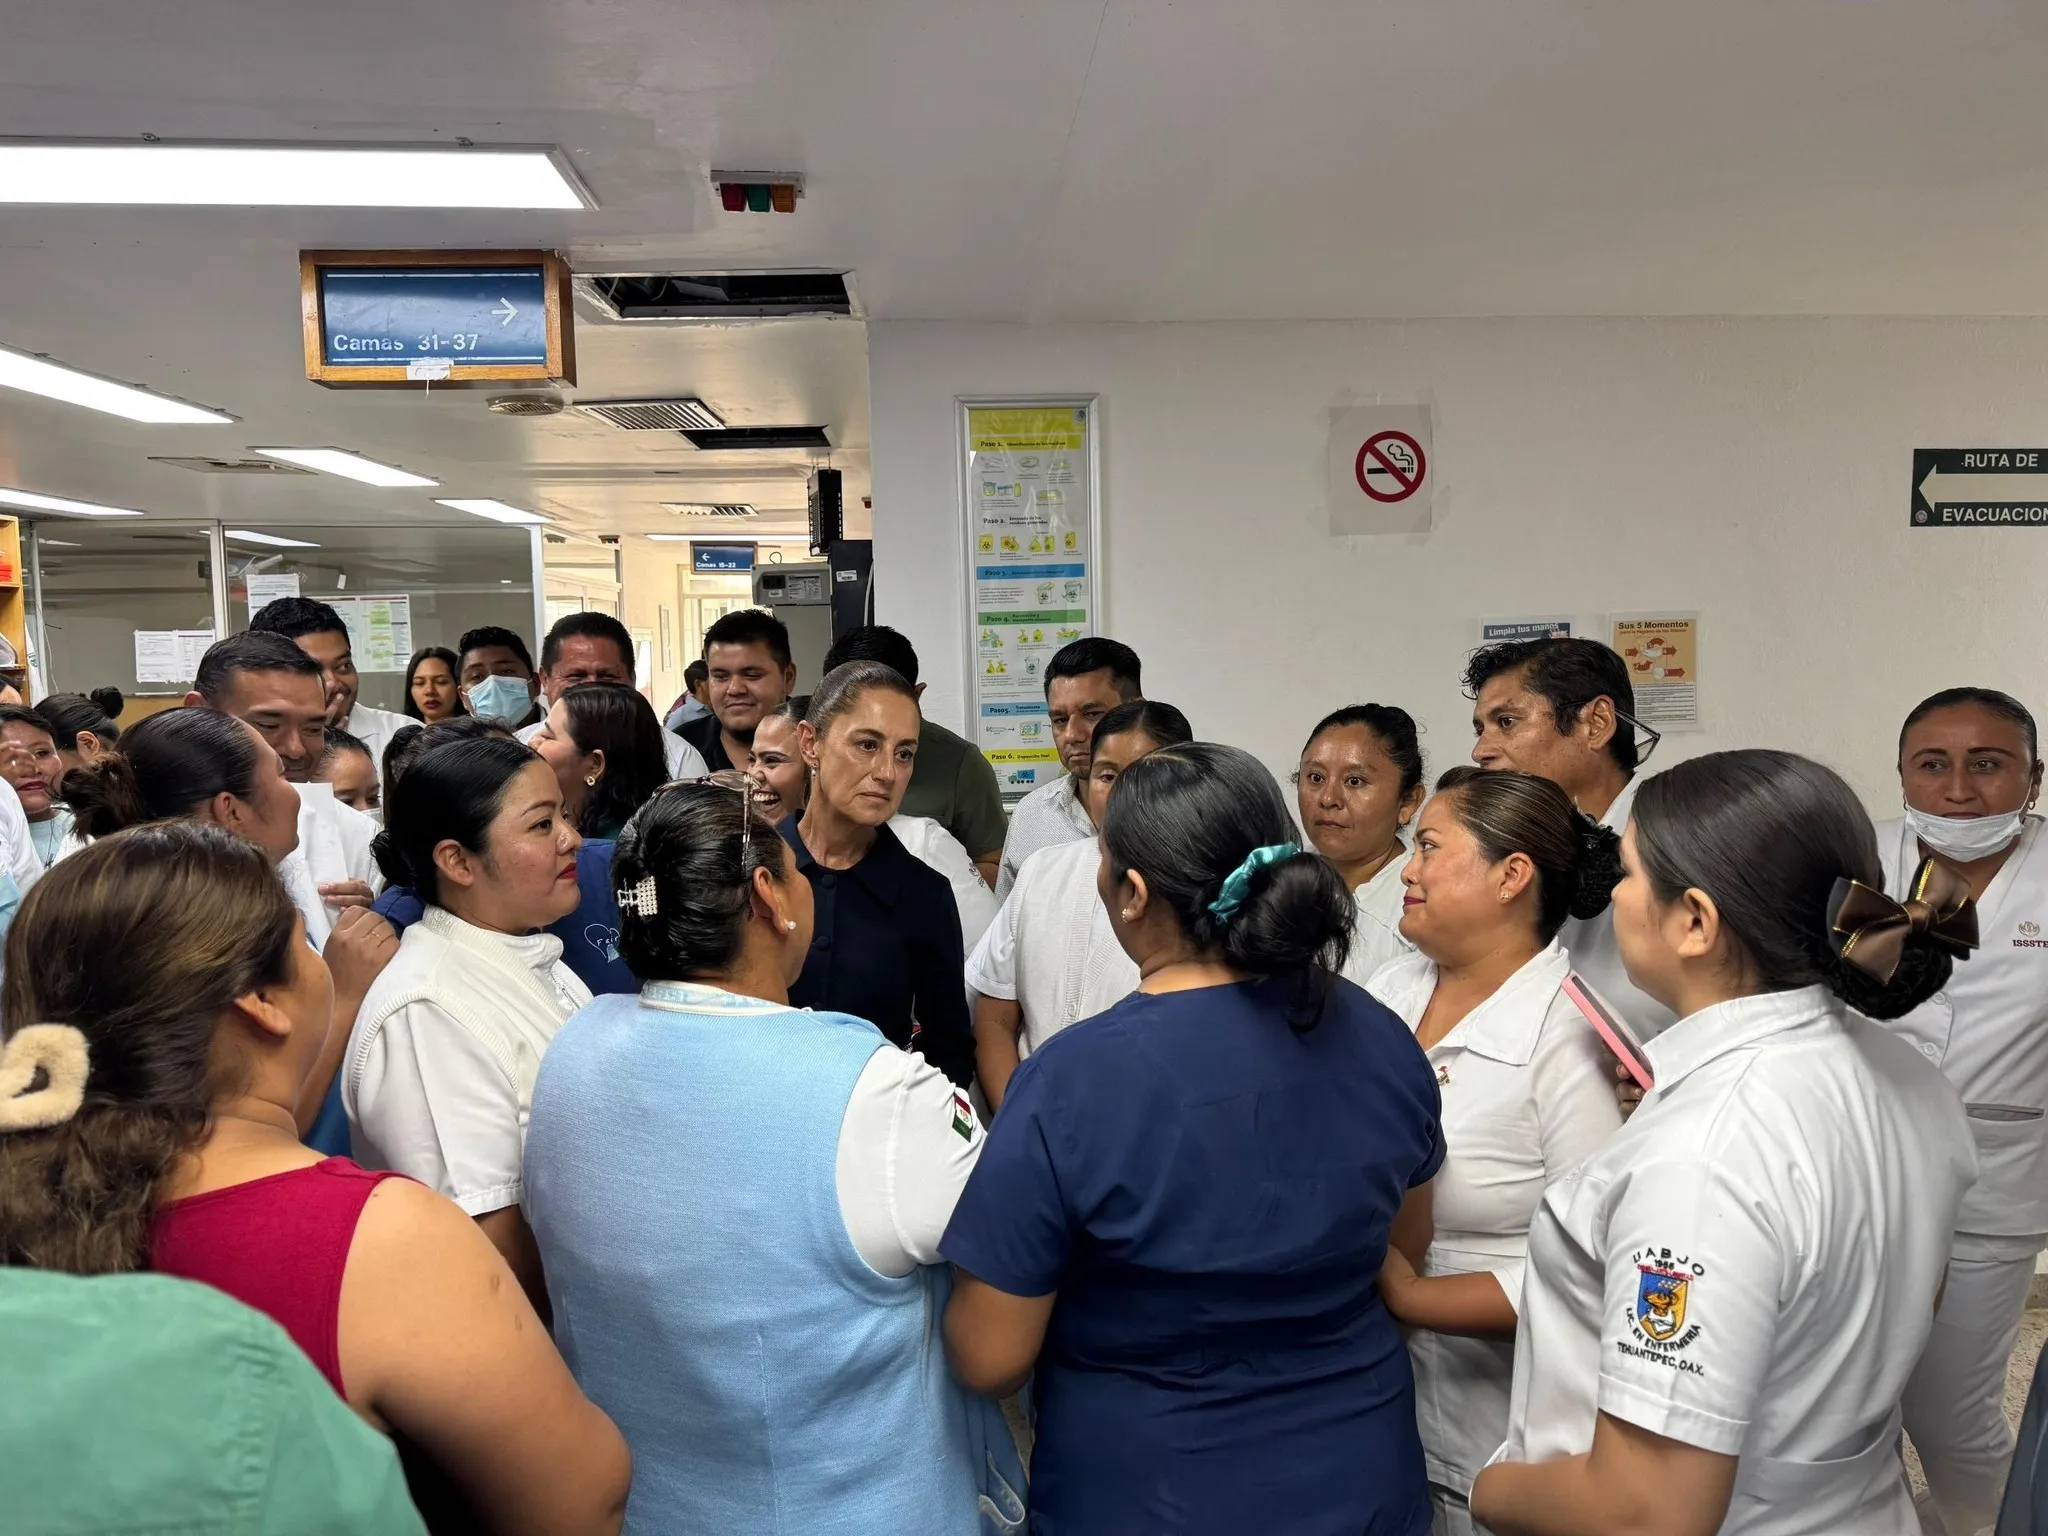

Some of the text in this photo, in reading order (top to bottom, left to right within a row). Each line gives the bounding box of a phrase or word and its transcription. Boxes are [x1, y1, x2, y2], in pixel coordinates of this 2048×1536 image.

[333, 333, 479, 351] Camas 31-37
[1964, 453, 2039, 468] RUTA DE
[1489, 623, 1559, 637] Limpia tus manos
[1618, 622, 1634, 630] Sus
[1644, 621, 1689, 629] Momentos
[2012, 939, 2048, 949] ISSSTE
[1632, 1246, 1705, 1277] UABJO
[1632, 1327, 1645, 1341] EN
[1644, 1324, 1702, 1353] ENFERMERIA
[1678, 1359, 1705, 1377] OAX.
